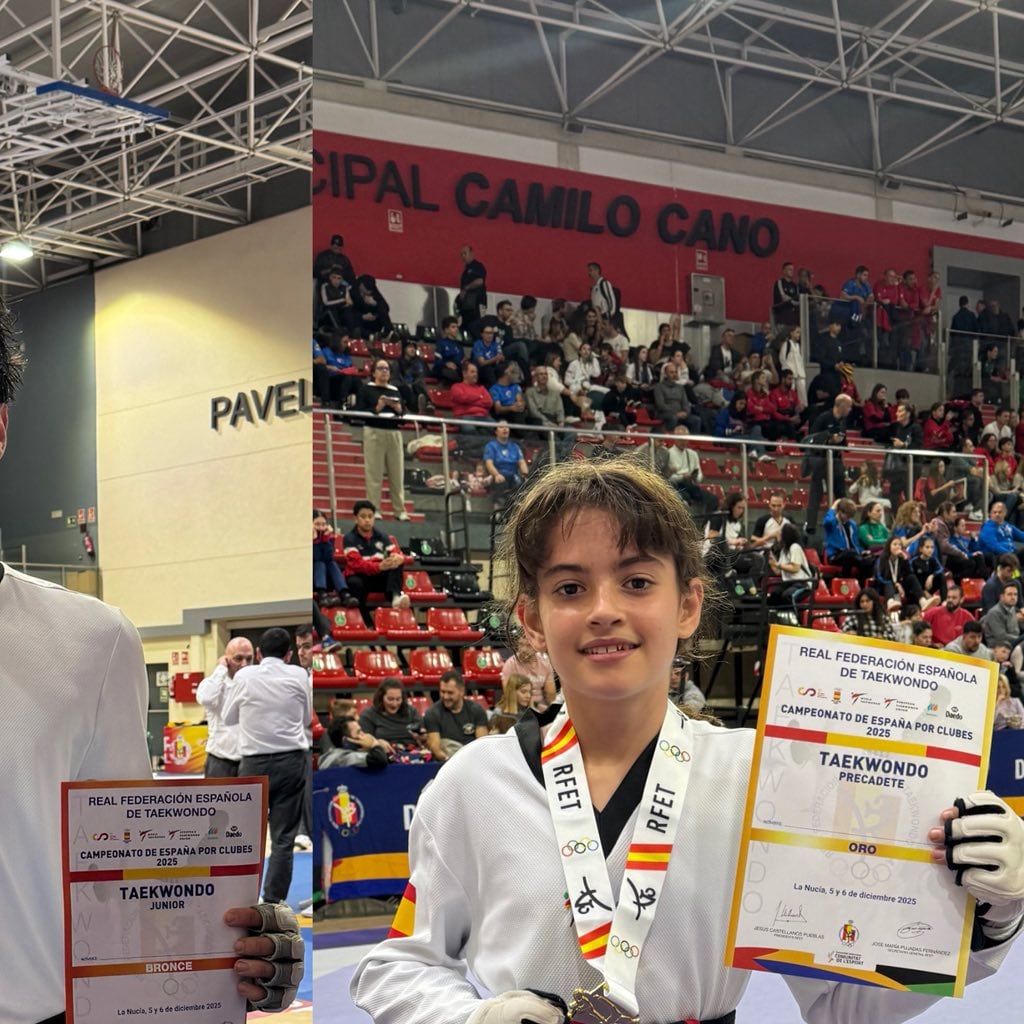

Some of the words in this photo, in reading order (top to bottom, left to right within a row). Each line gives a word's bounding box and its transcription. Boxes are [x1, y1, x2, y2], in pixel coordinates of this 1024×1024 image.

[454, 171, 642, 238] CAMILO
[657, 203, 781, 259] CANO
[210, 377, 313, 432] PAVEL
[799, 646, 832, 661] REAL
[836, 651, 915, 673] FEDERACIÓN
[918, 664, 978, 685] ESPAÑOLA
[840, 667, 857, 679] DE
[861, 670, 939, 692] TAEKWONDO
[781, 704, 852, 723] CAMPEONATO
[855, 714, 868, 725] DE
[871, 716, 912, 731] ESPAÑA
[914, 722, 935, 734] POR
[937, 726, 974, 741] CLUBES
[866, 726, 891, 738] 2025
[819, 751, 929, 779] TAEKWONDO
[552, 763, 582, 810] RFET
[839, 771, 905, 789] PRECADETE
[88, 796, 117, 806] REAL
[121, 792, 193, 805] FEDERACIÓN
[196, 791, 252, 803] ESPAÑOLA
[126, 808, 142, 819] DE
[144, 807, 216, 819] TAEKWONDO
[646, 783, 676, 834] RFET
[80, 849, 143, 860] CAMPEONATO
[146, 848, 157, 857] DE
[159, 845, 196, 857] ESPAÑA
[198, 846, 217, 855] POR
[219, 845, 253, 854] CLUBES
[848, 842, 877, 856] ORO
[156, 857, 178, 867] 2025
[119, 883, 215, 900] TAEKWONDO
[793, 882, 803, 891] La
[829, 887, 834, 895] 5
[841, 888, 847, 897] 6
[848, 889, 858, 898] de
[859, 890, 896, 904] diciembre
[897, 895, 917, 906] 2025
[150, 900, 185, 910] JUNIOR
[145, 961, 193, 973] BRONCE
[148, 1006, 153, 1014] 5
[165, 1005, 173, 1013] de
[174, 1003, 206, 1013] diciembre
[206, 1002, 222, 1010] 2025
